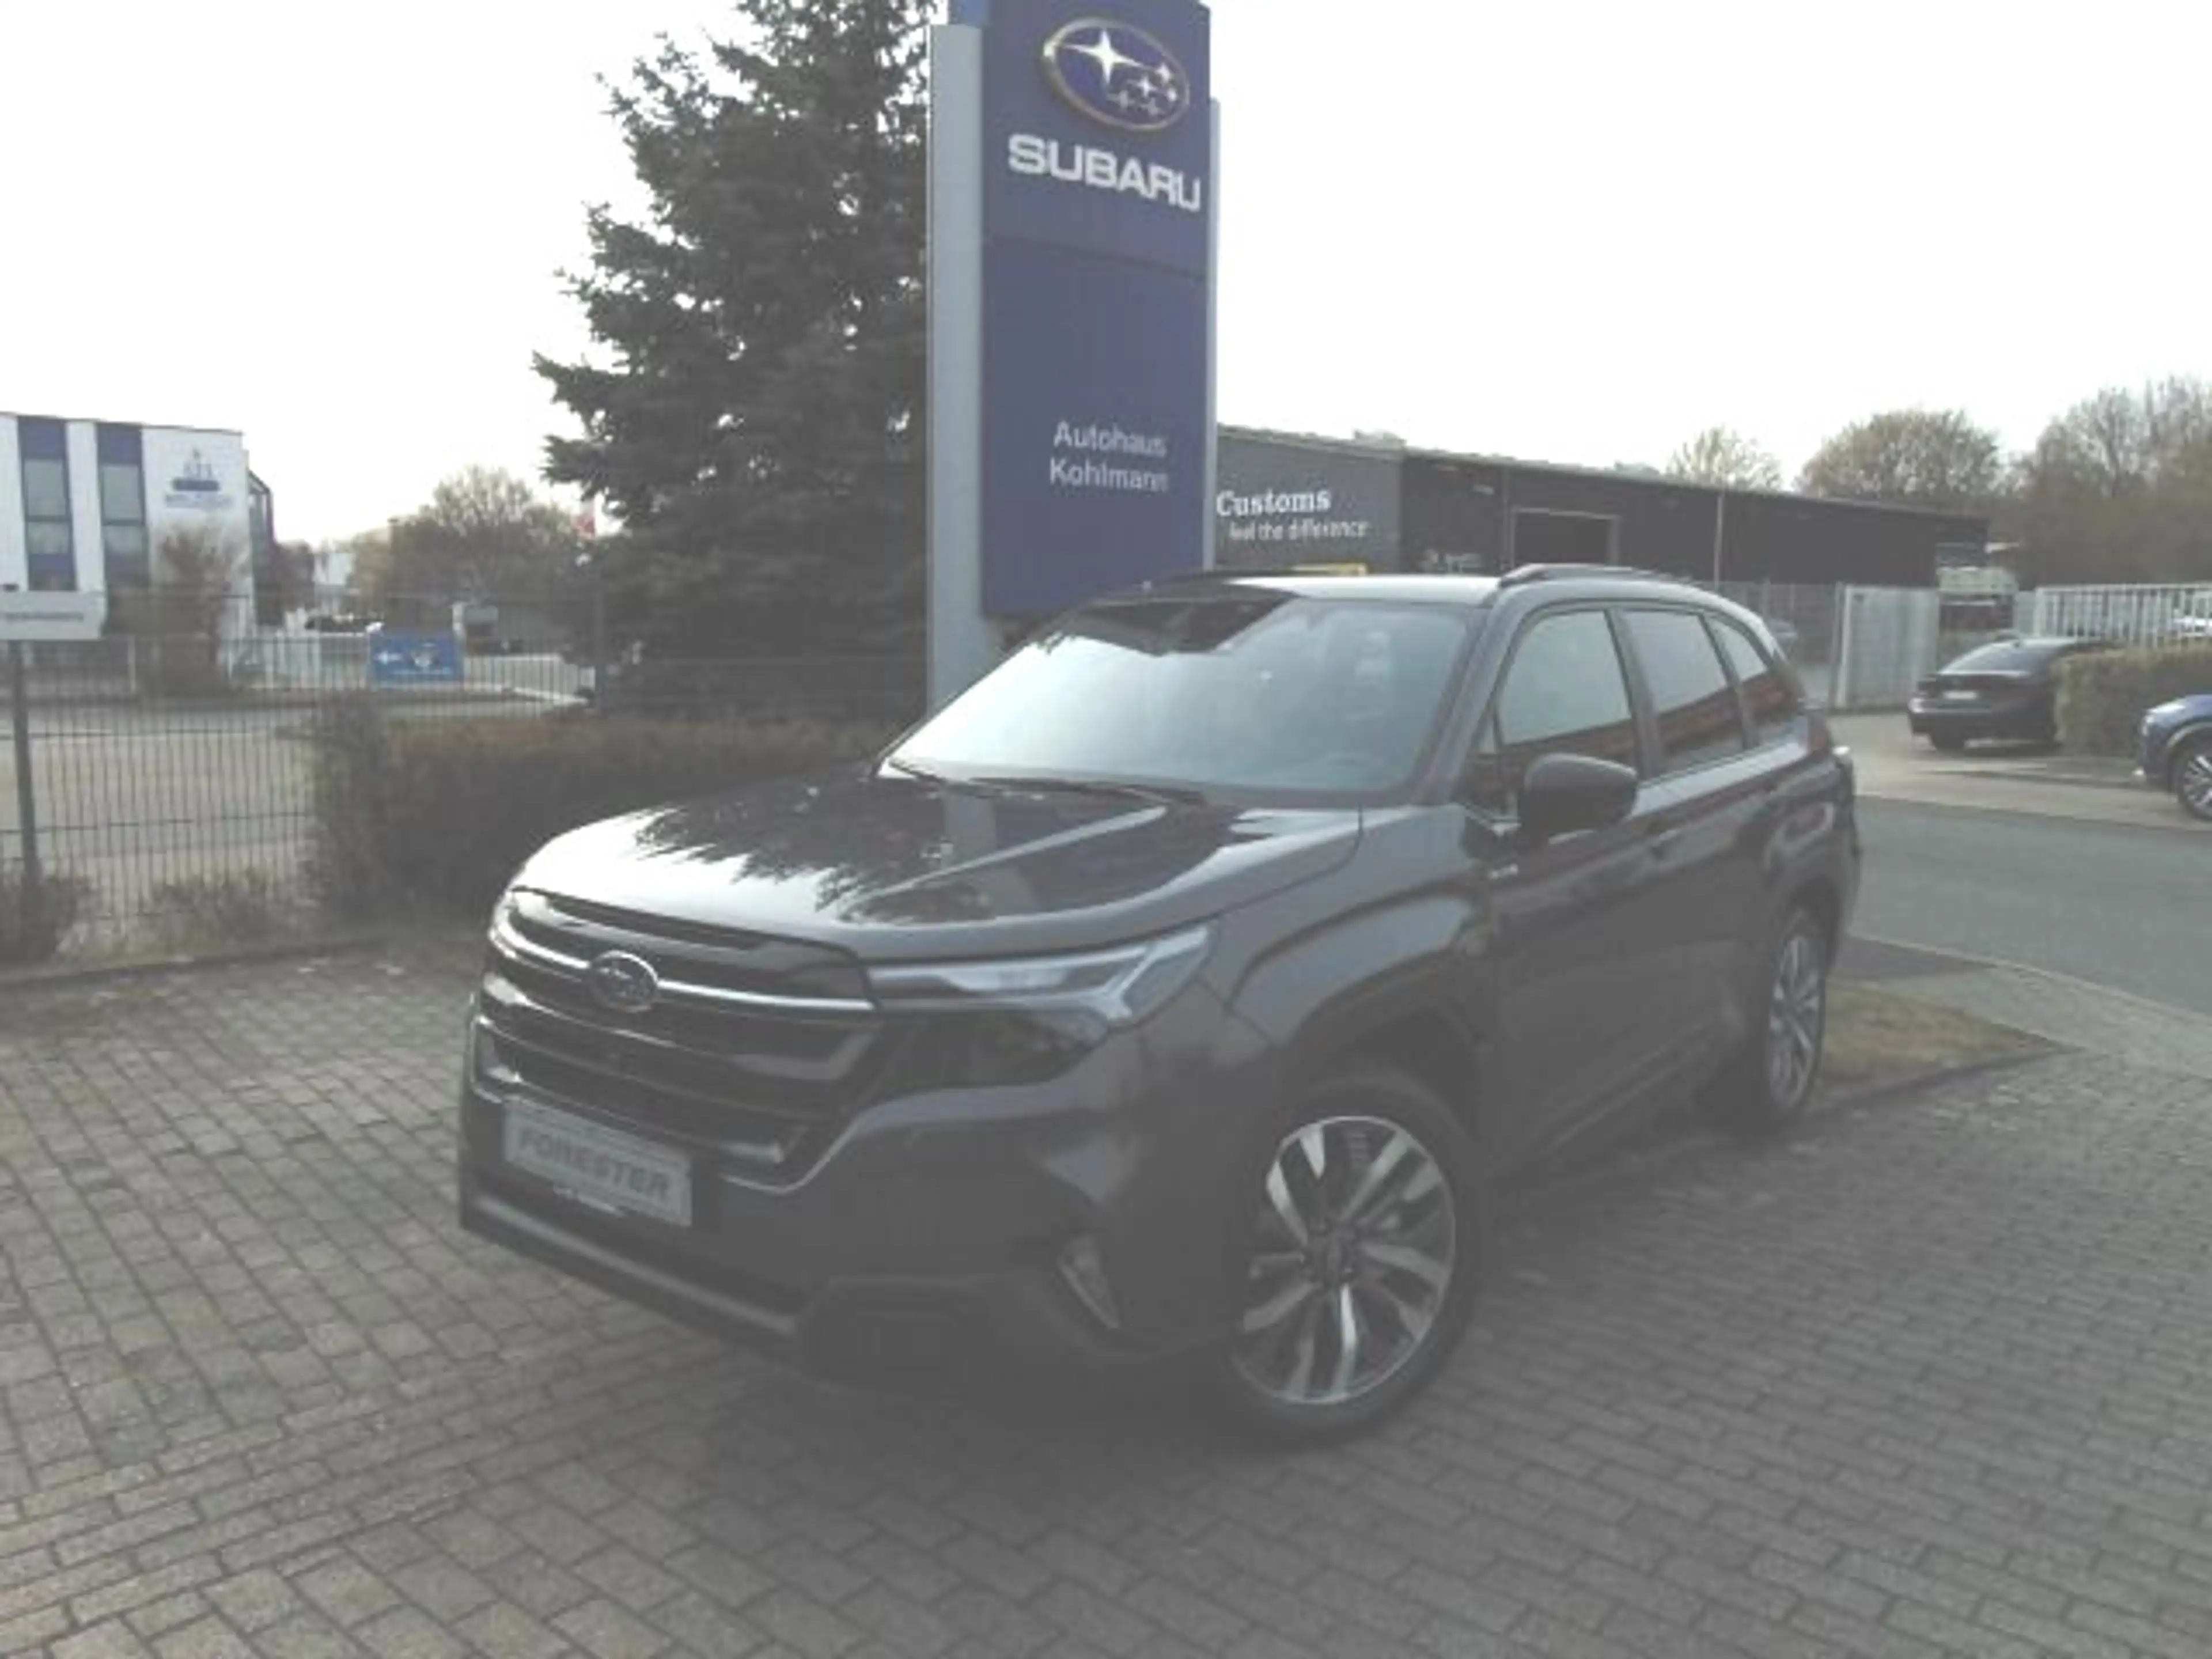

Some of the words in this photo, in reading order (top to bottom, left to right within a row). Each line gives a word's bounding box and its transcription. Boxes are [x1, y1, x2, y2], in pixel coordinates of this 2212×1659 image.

[1008, 134, 1200, 212] SUBARU
[1053, 421, 1167, 457] Autohaus
[1050, 457, 1169, 492] Kohlmann
[1216, 488, 1331, 516] Customs
[519, 1126, 670, 1203] FORESTER
